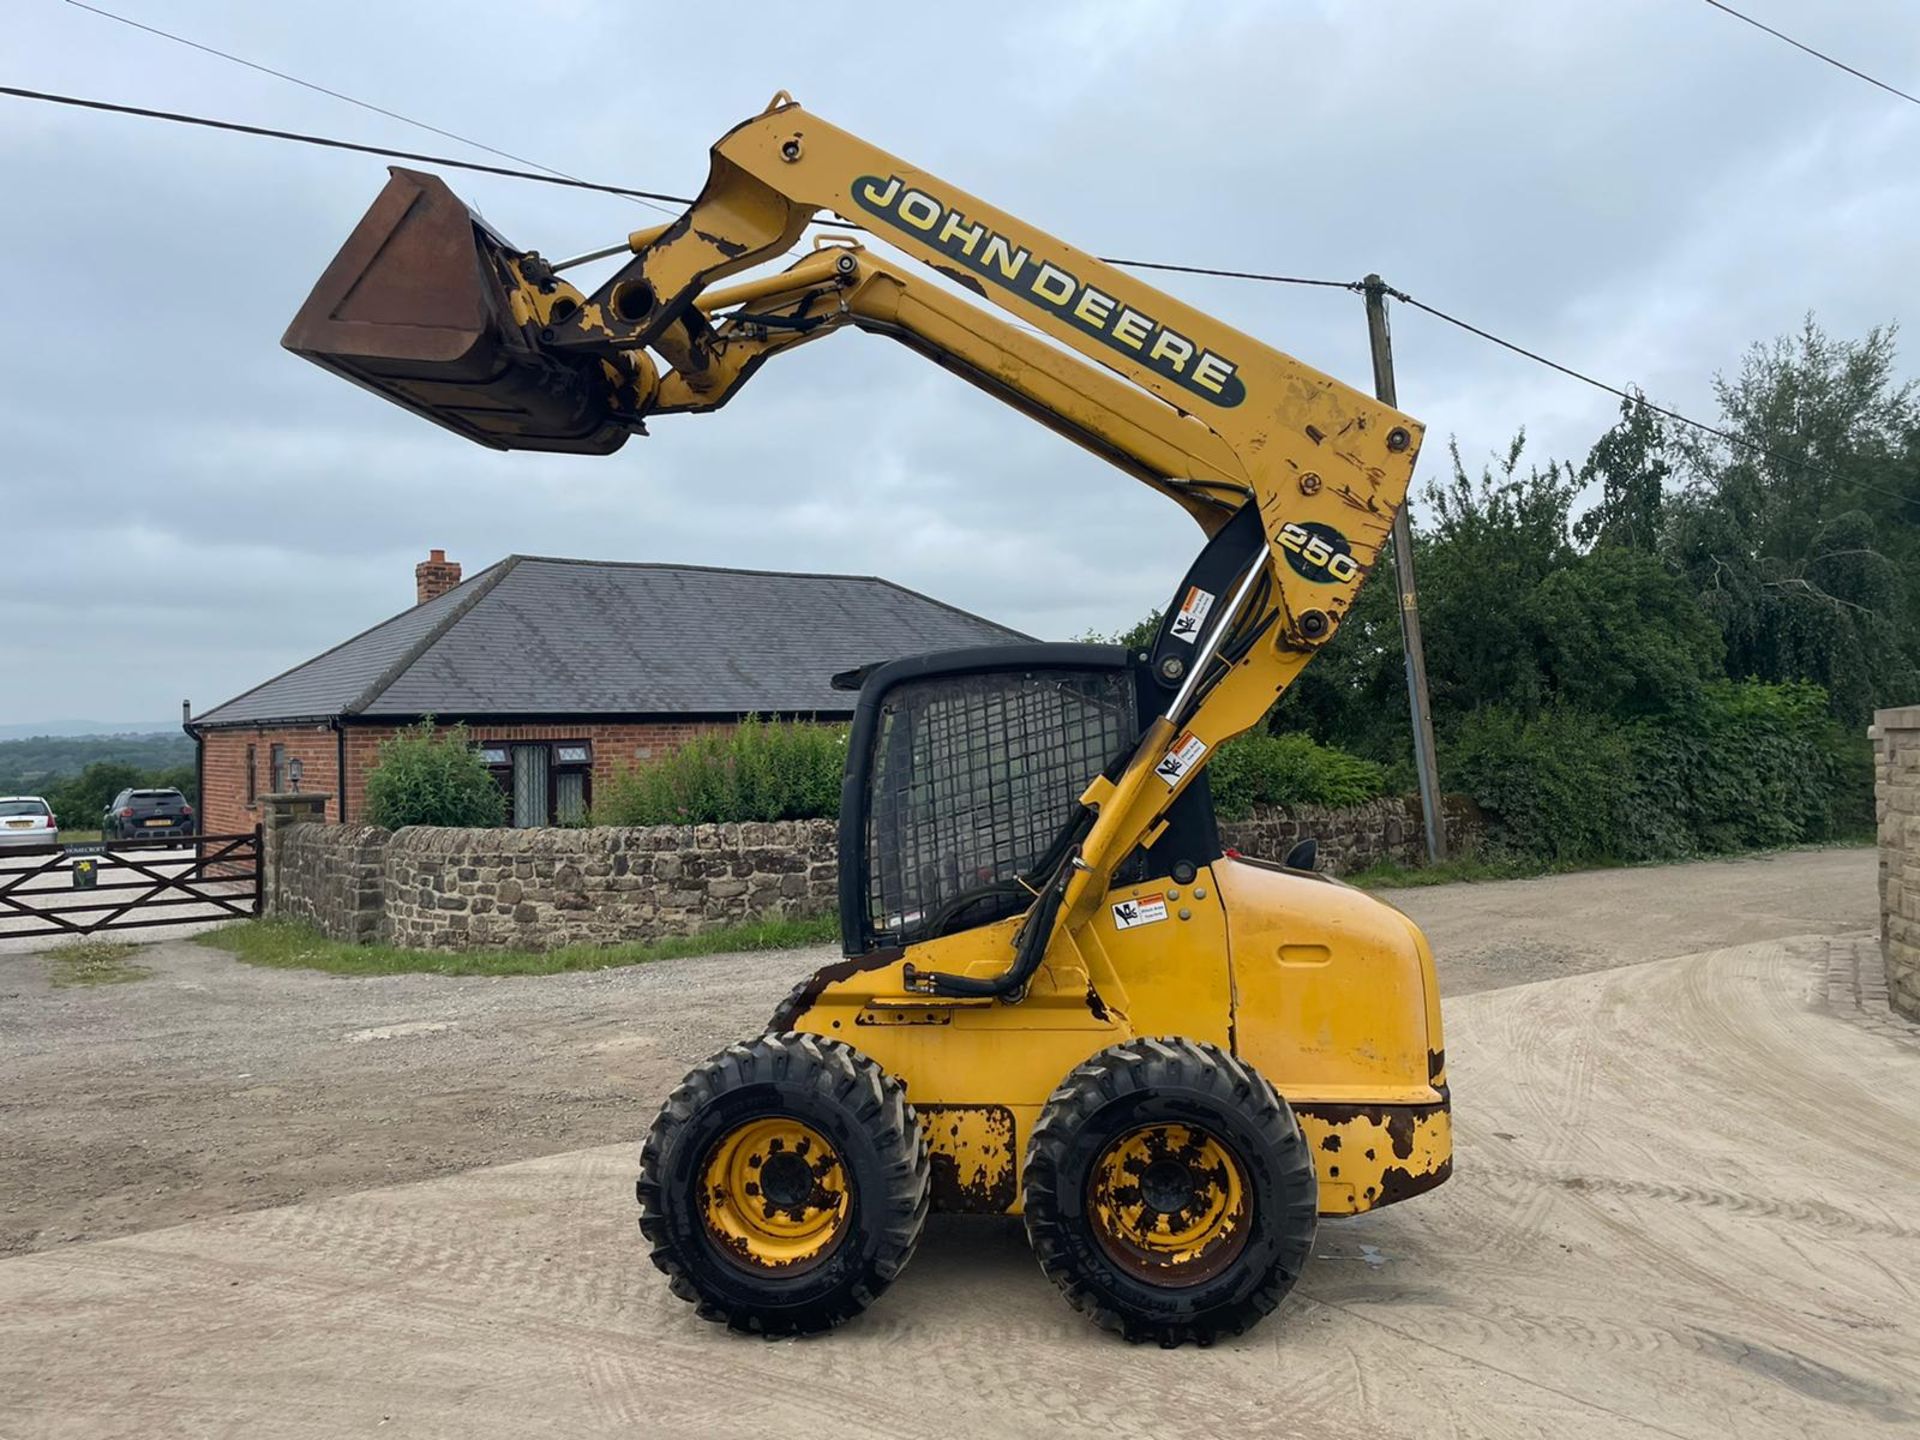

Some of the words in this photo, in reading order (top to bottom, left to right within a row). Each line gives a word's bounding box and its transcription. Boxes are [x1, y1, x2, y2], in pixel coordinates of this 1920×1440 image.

[863, 176, 1028, 281] JOHN
[1031, 259, 1234, 394] DEERE
[1276, 523, 1358, 582] 250
